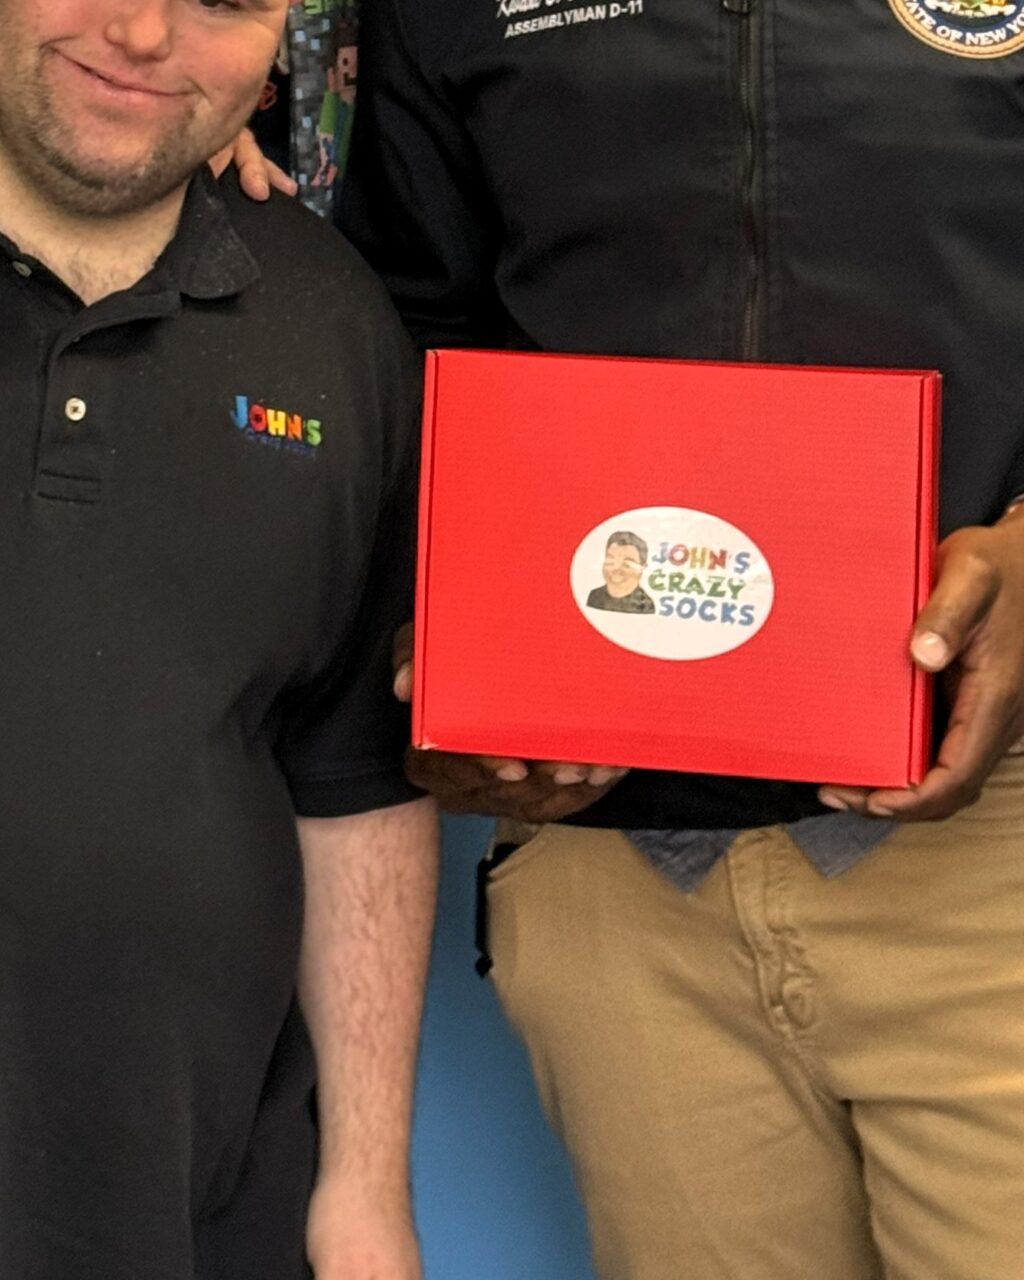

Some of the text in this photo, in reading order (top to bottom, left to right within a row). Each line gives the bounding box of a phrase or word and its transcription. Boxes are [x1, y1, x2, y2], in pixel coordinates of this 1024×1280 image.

[504, 4, 607, 39] ASSEMBLYMAN
[935, 25, 964, 44] OF
[964, 27, 1007, 46] NEW
[651, 541, 751, 575] JOHN'S
[647, 568, 746, 601] CRAZY
[658, 595, 756, 627] SOCKS
